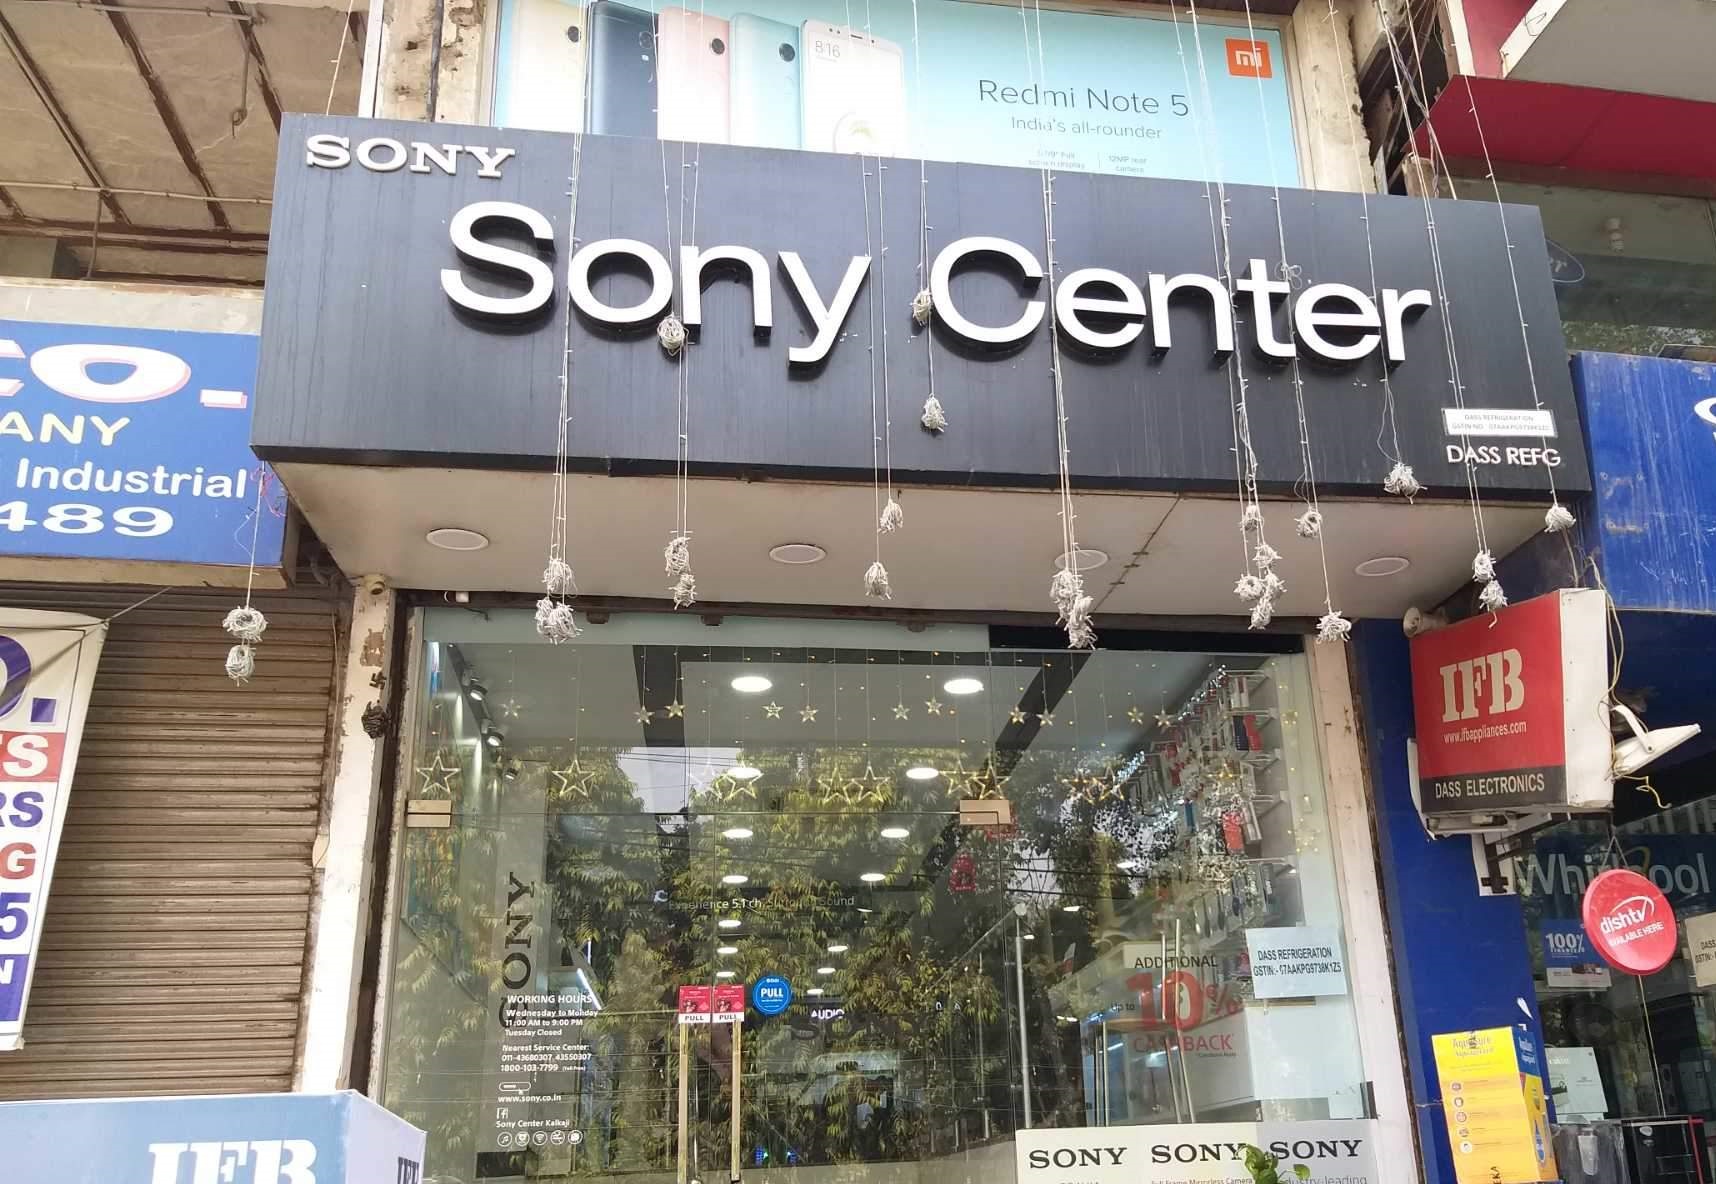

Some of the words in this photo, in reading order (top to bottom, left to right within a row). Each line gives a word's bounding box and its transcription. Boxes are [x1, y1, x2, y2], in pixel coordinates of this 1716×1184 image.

[979, 80, 1075, 108] Redmi
[1087, 88, 1159, 114] Note
[1171, 94, 1189, 117] 5
[1011, 117, 1067, 133] India's
[1072, 121, 1162, 139] all-rounder
[306, 134, 516, 178] SONY
[441, 201, 873, 366] Sony
[930, 236, 1432, 364] Center
[1446, 445, 1502, 464] DASS
[1505, 447, 1561, 467] REFG
[16, 457, 247, 498] Industrial
[0, 500, 174, 537] 489
[1439, 648, 1525, 723] IFB
[1443, 721, 1527, 743] www.ifbappliances.com
[1435, 781, 1461, 799] DASS
[1466, 773, 1545, 796] ELECTRONICS
[1643, 921, 1665, 937] HERE
[499, 872, 534, 1028] SONY
[1258, 950, 1277, 960] DASS
[1277, 947, 1332, 960] REFRIGERATION
[1134, 955, 1218, 968] ADDITIONAL
[507, 995, 555, 1004] WORKING
[558, 994, 593, 1004] HOURS
[761, 988, 784, 998] PULL
[505, 1009, 556, 1018] Wednesday
[567, 1009, 599, 1018] Monday
[504, 1029, 536, 1037] Tuesday
[537, 1028, 562, 1036] Closed
[497, 1094, 561, 1103] www.sony.co.in
[496, 1120, 515, 1129] Sony
[1029, 1147, 1127, 1169] SONY
[1151, 1143, 1247, 1164] SONY
[1270, 1140, 1363, 1160] SONY
